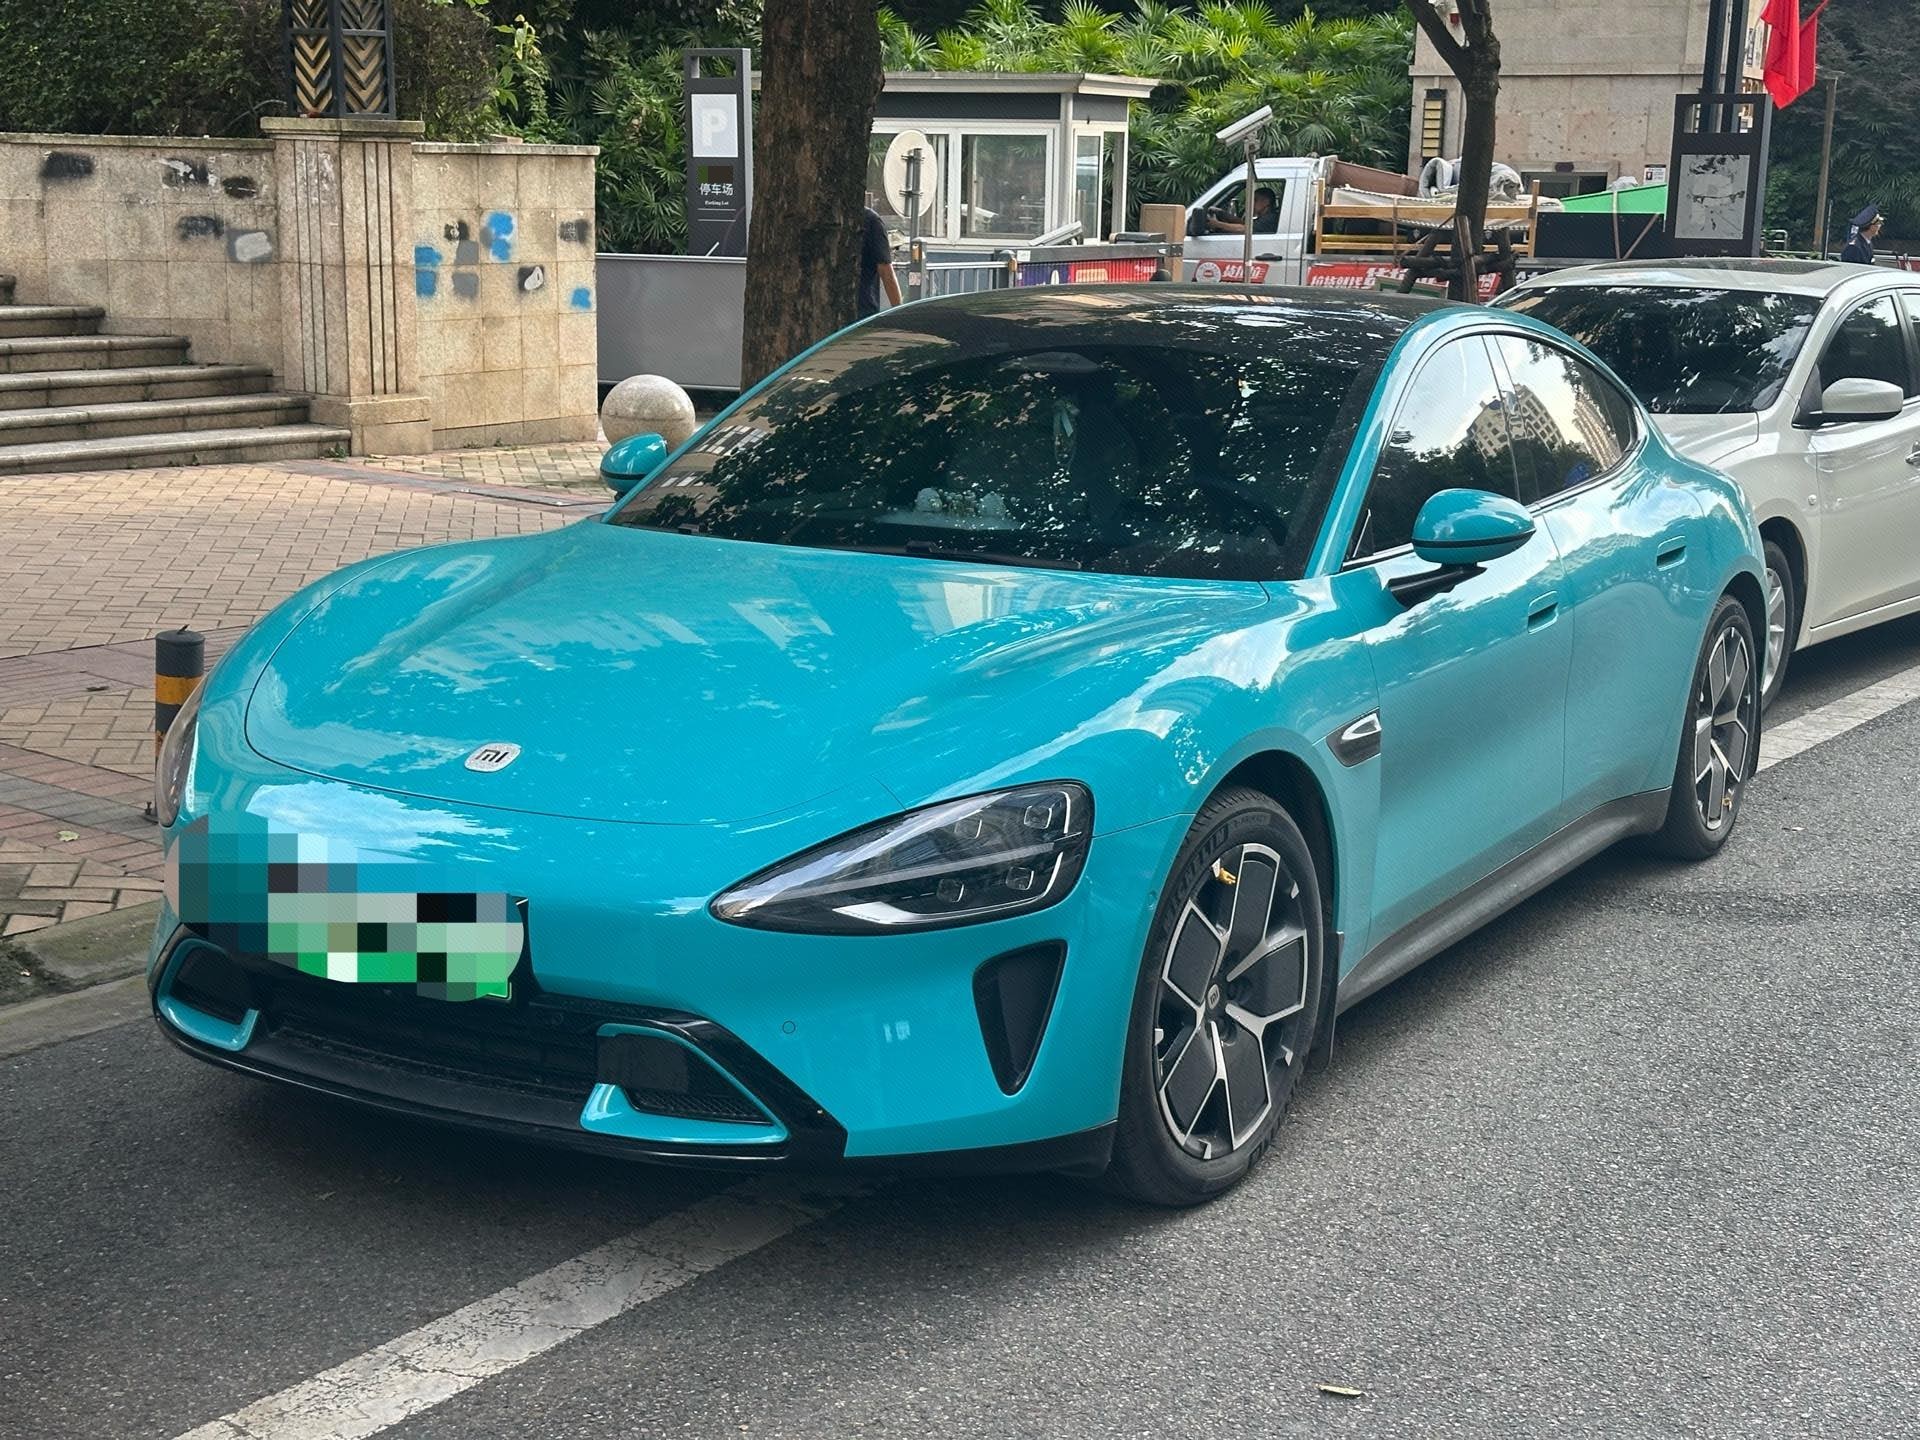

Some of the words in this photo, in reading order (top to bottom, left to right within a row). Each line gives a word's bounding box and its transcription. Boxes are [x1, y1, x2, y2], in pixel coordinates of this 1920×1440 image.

[703, 108, 728, 146] P
[700, 183, 734, 196] 停车场
